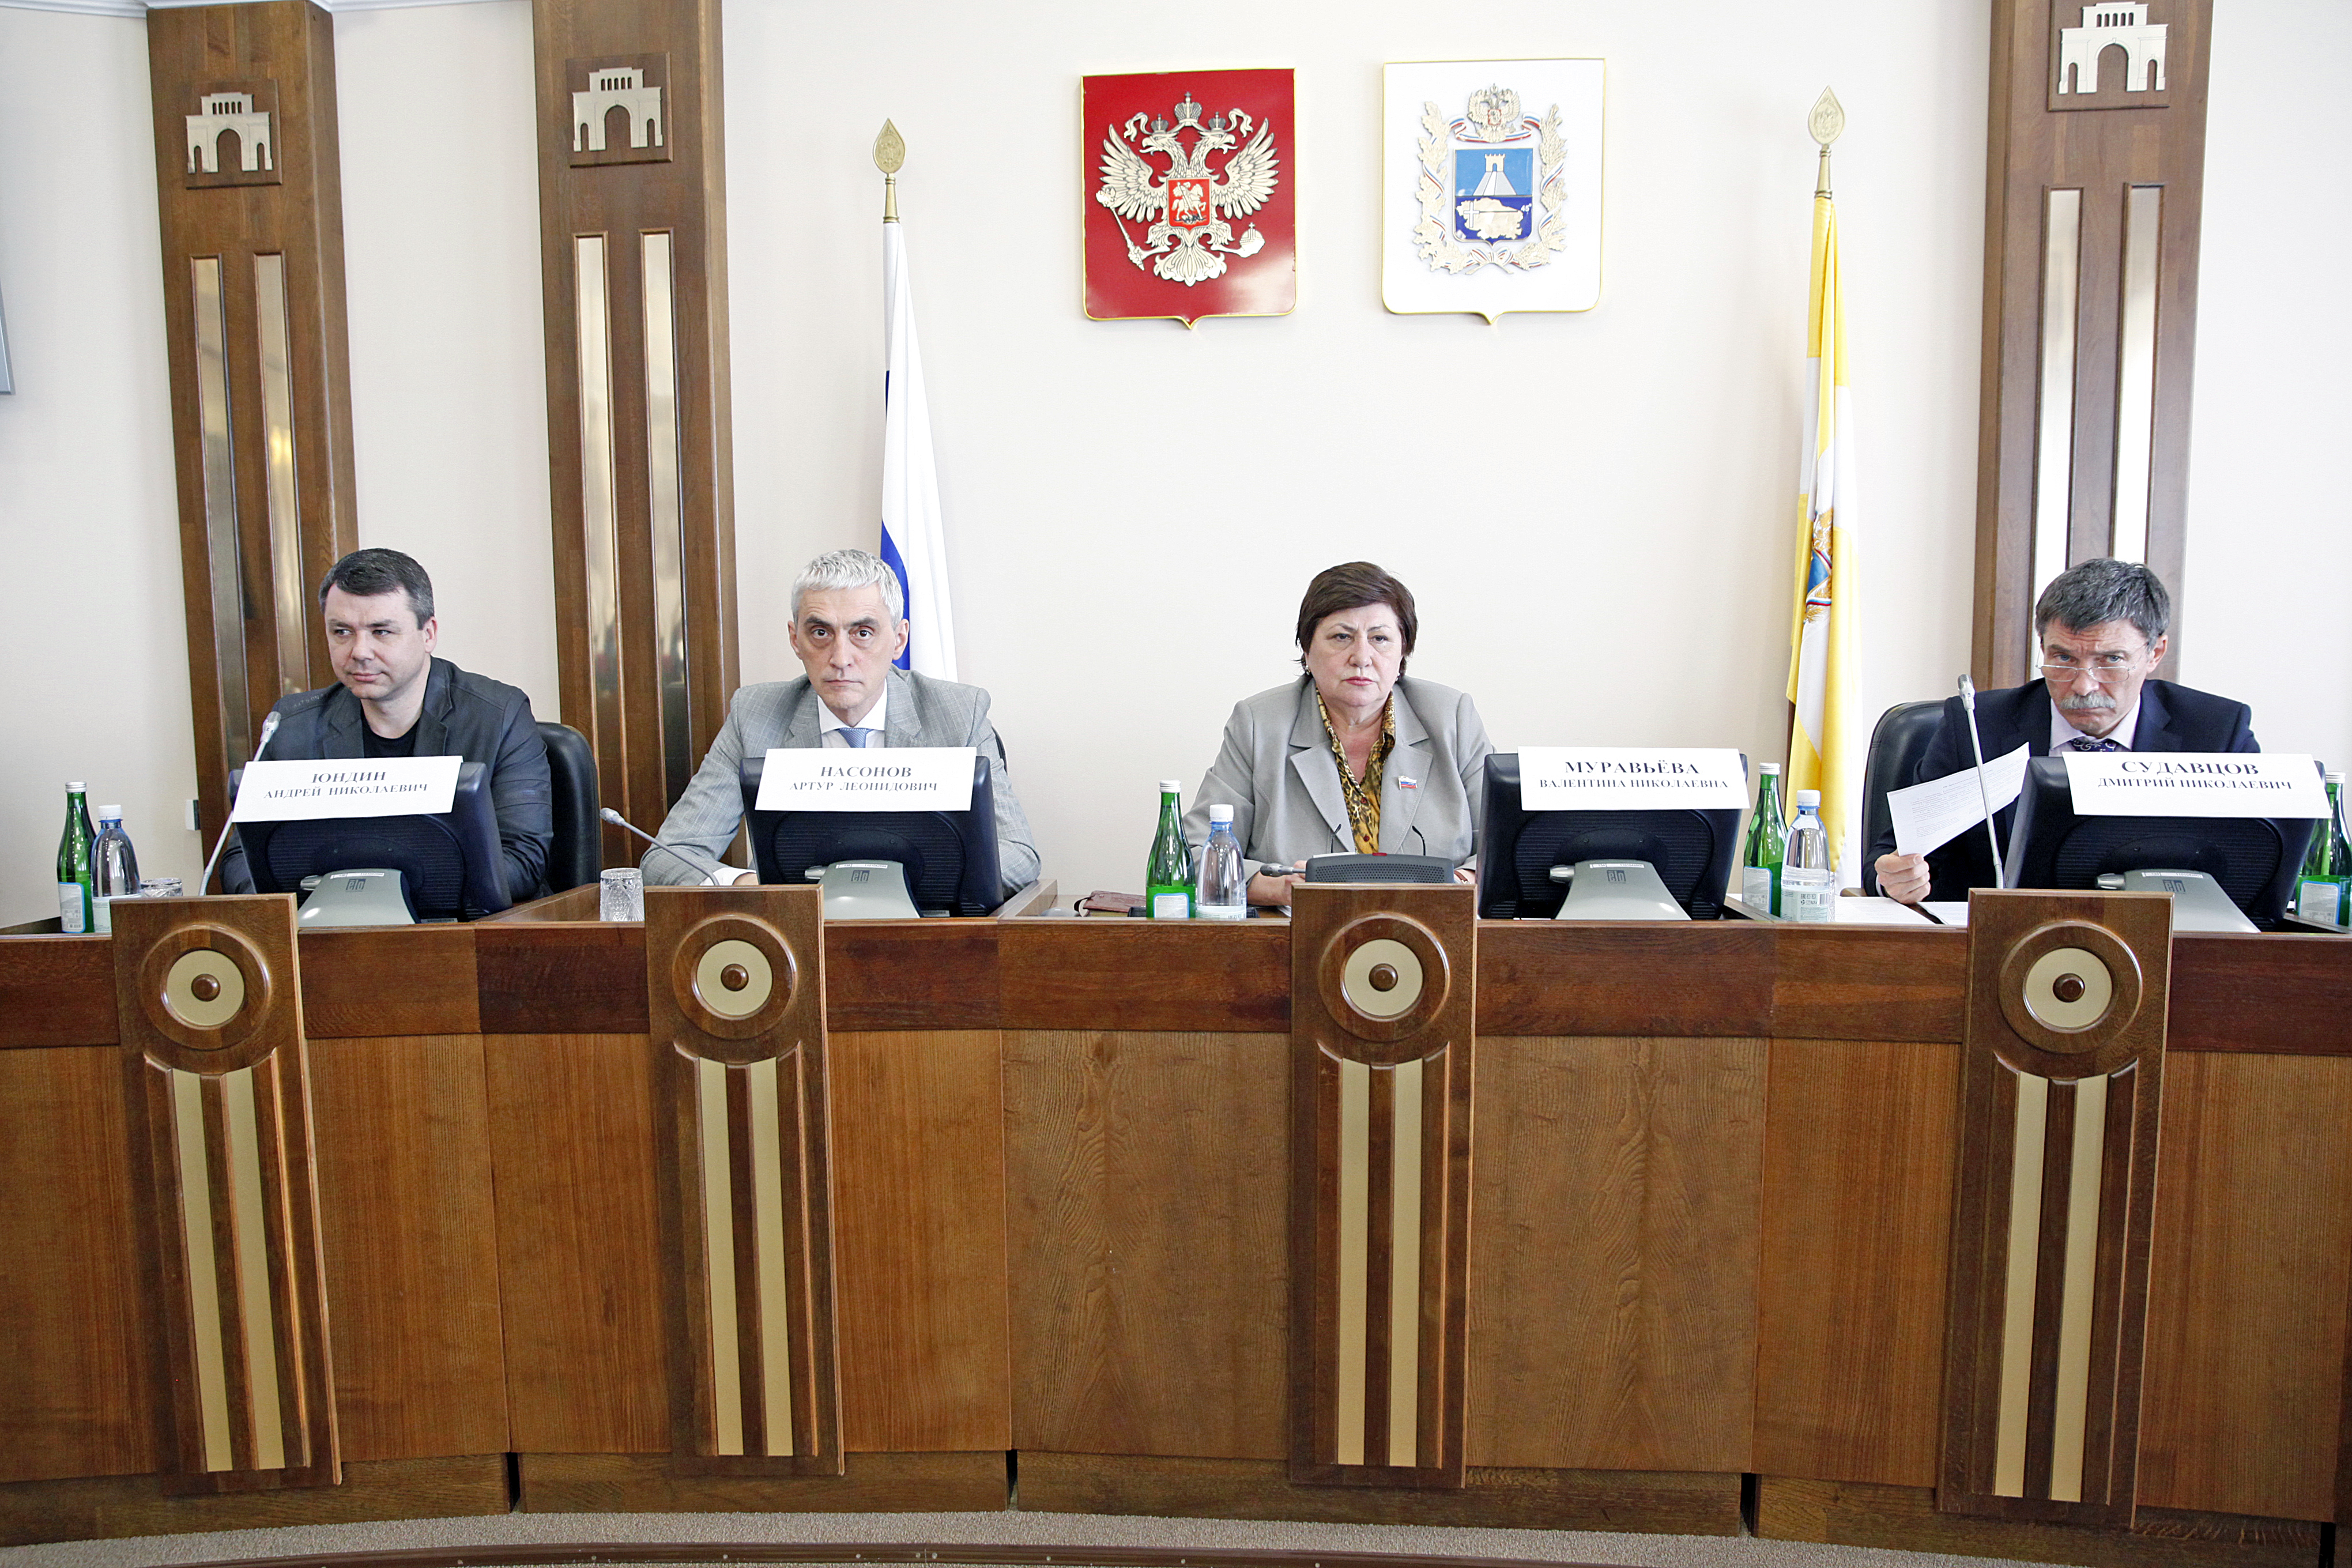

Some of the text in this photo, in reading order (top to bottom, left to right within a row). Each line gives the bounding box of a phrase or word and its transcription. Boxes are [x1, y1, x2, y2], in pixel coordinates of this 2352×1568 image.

[820, 766, 912, 778] НАСОНОВ
[1565, 760, 1700, 774] МУРАВЬЁВА
[2121, 761, 2259, 777] СУДАВЦОВ
[311, 771, 387, 783] ЮНДИН
[789, 782, 937, 792] АРТУР ЛЕОНИДОВИЧ
[1539, 779, 1729, 789] ВАЛЕНТИНА НИКОЛАЕВНА
[2098, 777, 2293, 790] ДМИТРИЙ НИКОЛАЕВИЧ
[263, 783, 428, 799] АНДРЕЙ НИКОЛАЕВИЧ
